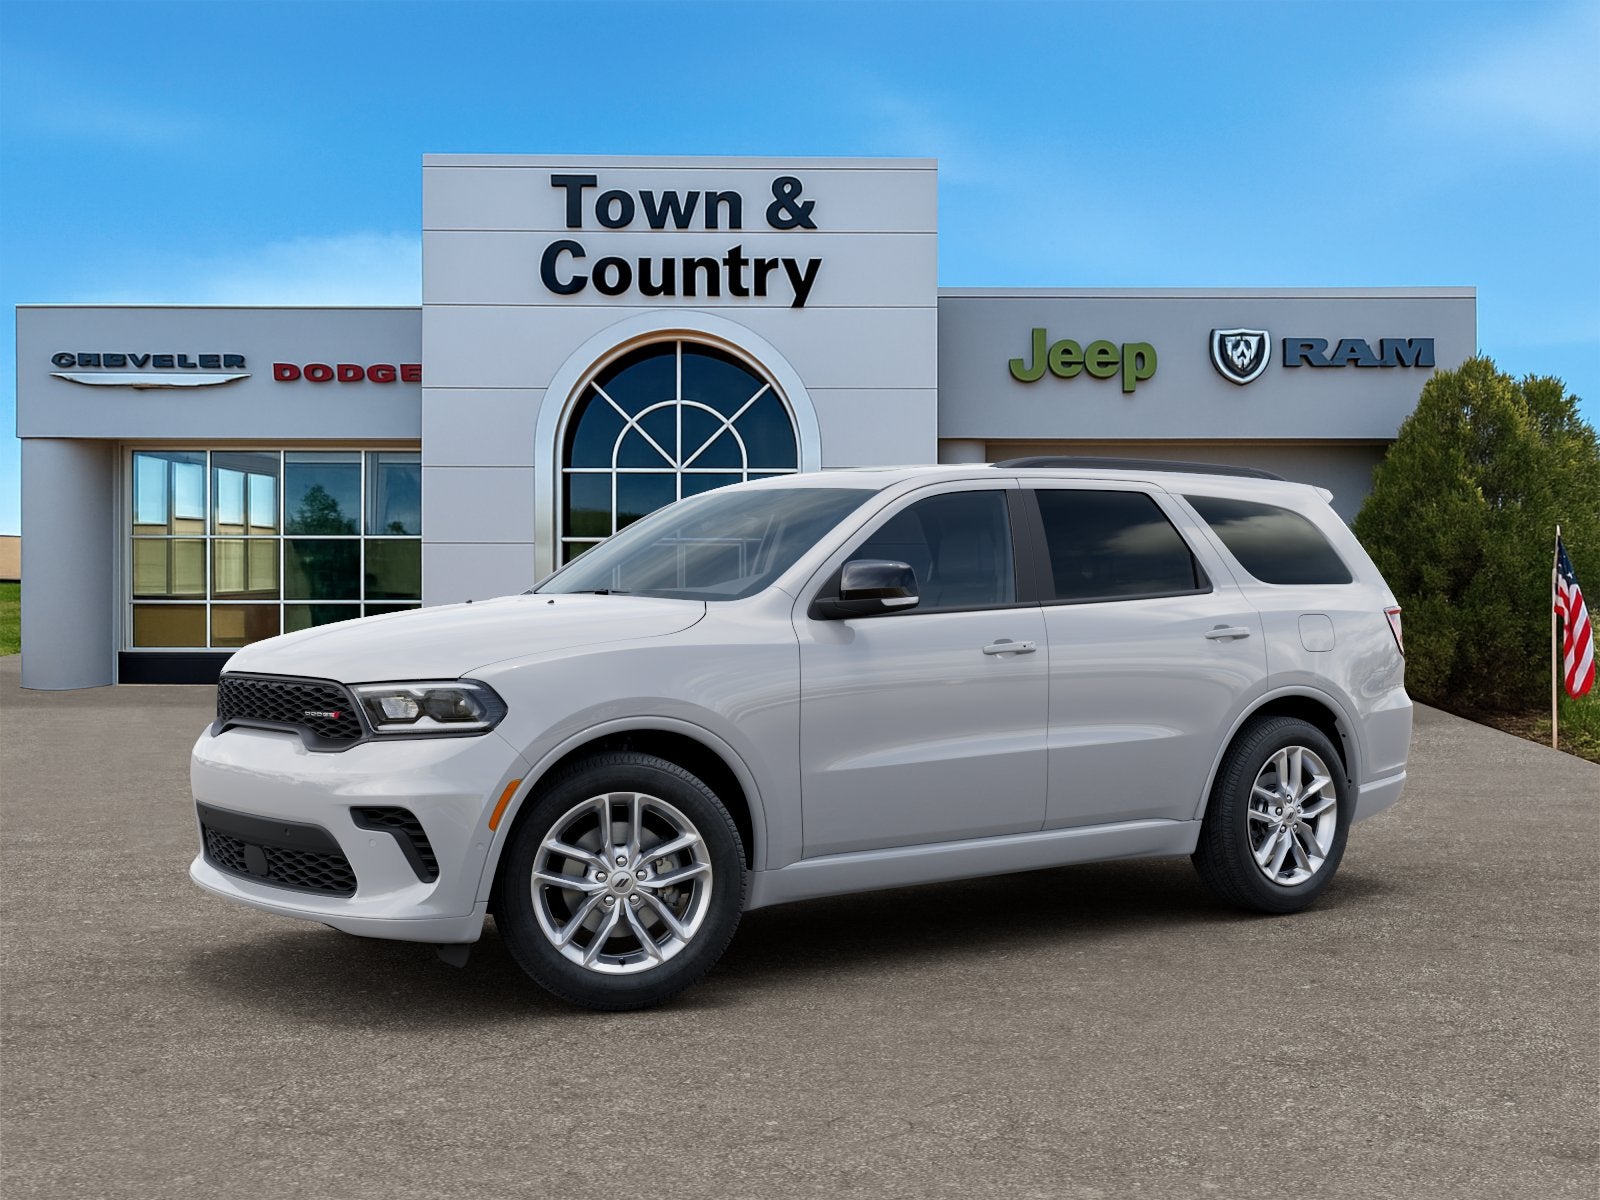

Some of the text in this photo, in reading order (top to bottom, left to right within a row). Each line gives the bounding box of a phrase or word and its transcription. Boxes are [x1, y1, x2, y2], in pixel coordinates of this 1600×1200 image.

[551, 174, 818, 230] Town &
[540, 239, 822, 308] Country
[273, 363, 422, 383] DODGE
[1009, 328, 1158, 393] Jeep
[1283, 338, 1435, 367] RAM
